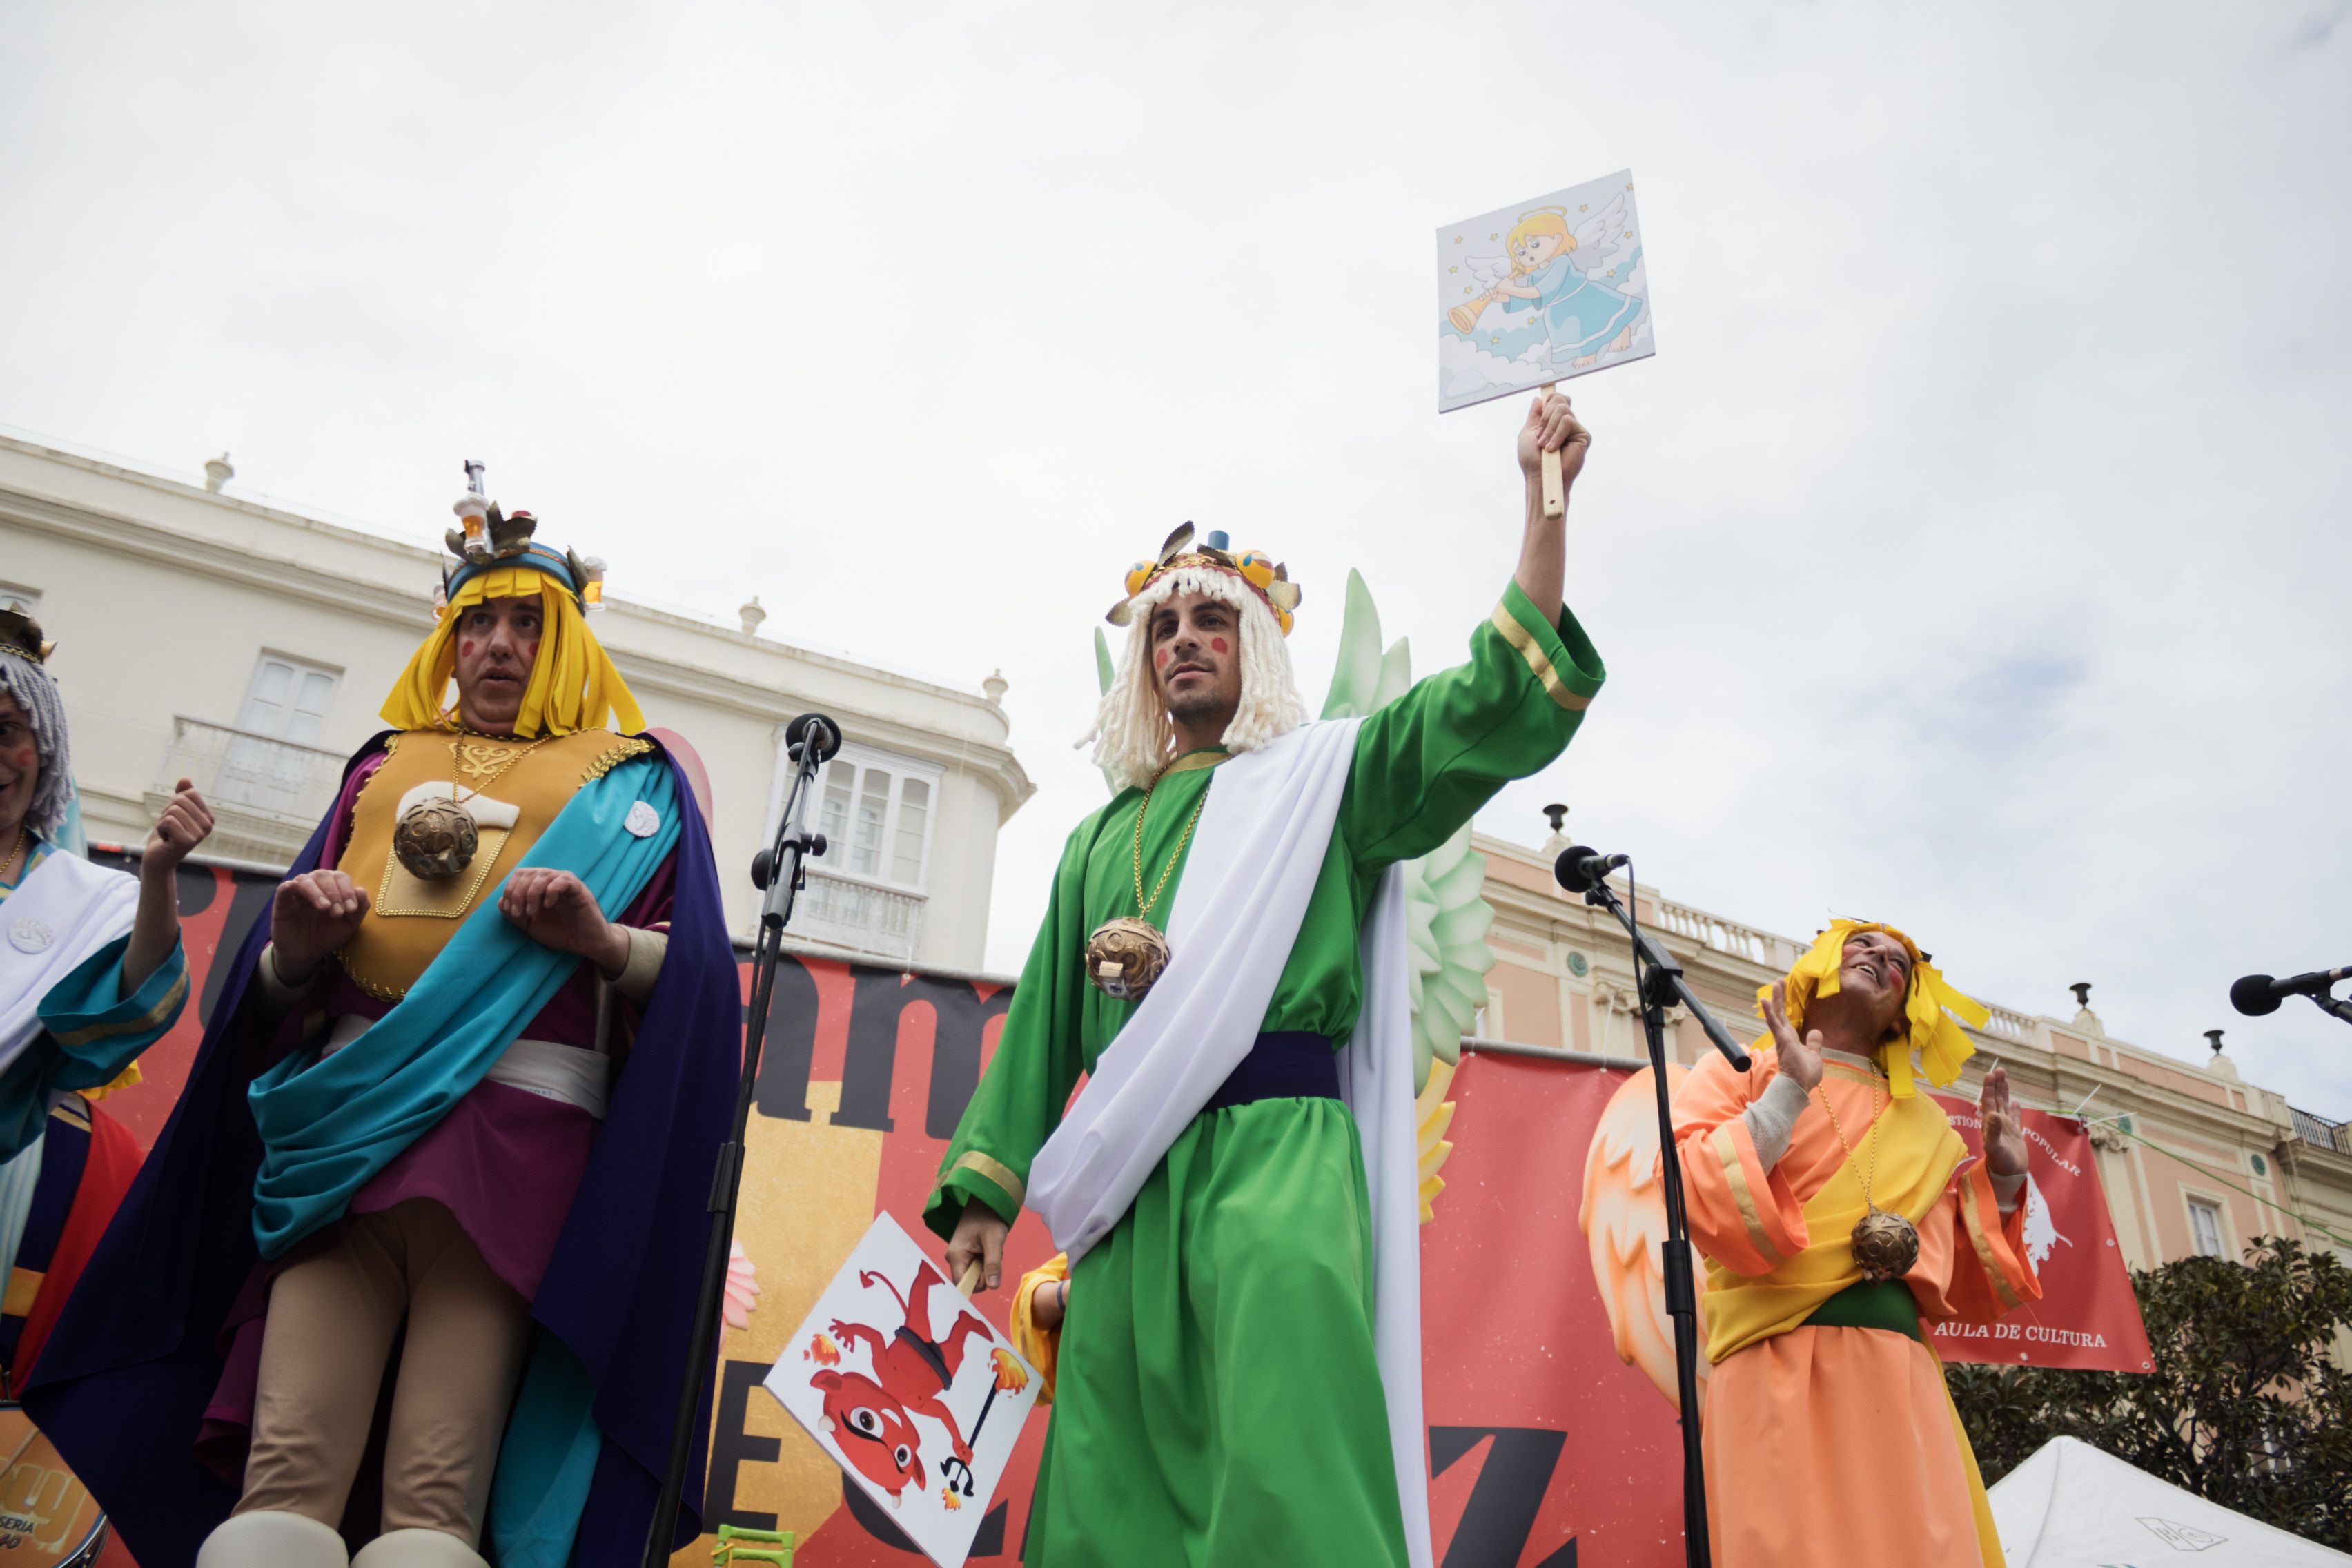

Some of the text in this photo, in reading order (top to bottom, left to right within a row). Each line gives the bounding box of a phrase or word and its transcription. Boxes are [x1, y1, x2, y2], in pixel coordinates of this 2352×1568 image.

[2021, 1126, 2081, 1176] POPULAR
[1934, 1322, 2107, 1347] AULA DE CULTURA
